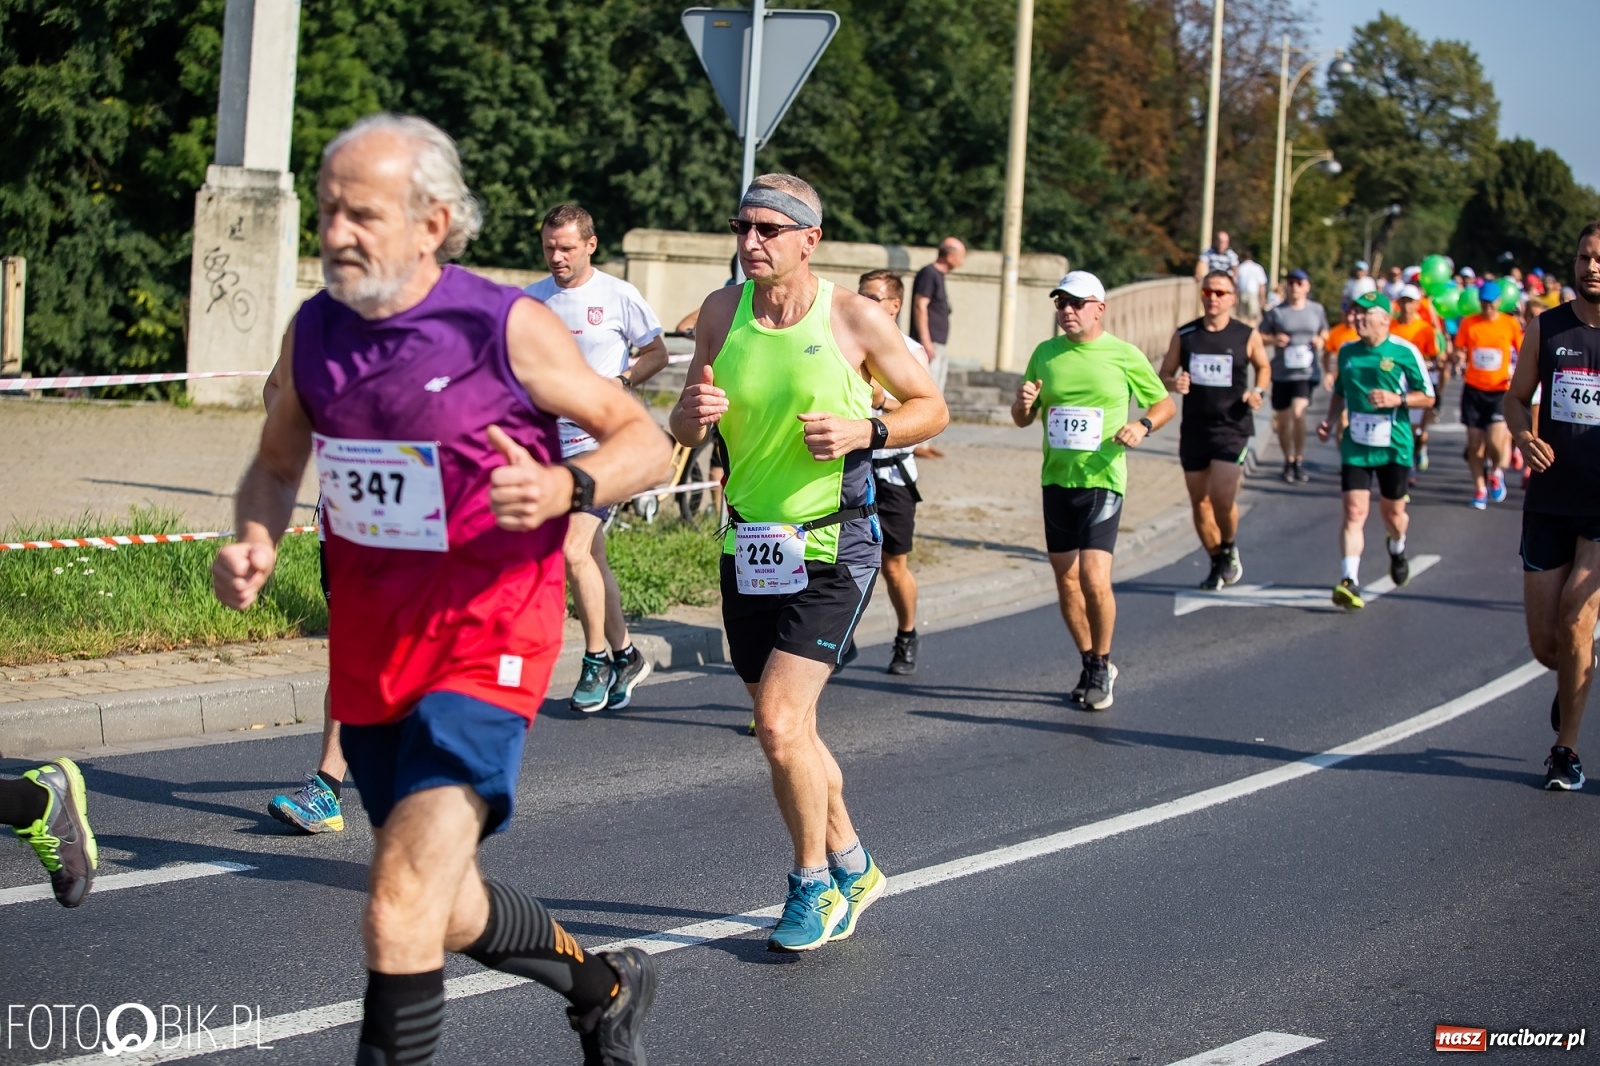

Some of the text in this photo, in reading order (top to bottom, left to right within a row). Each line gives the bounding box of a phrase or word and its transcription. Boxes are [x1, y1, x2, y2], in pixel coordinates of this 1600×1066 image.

[804, 344, 822, 355] 4F
[1063, 418, 1088, 432] 193
[347, 470, 405, 506] 347
[746, 542, 784, 566] 226
